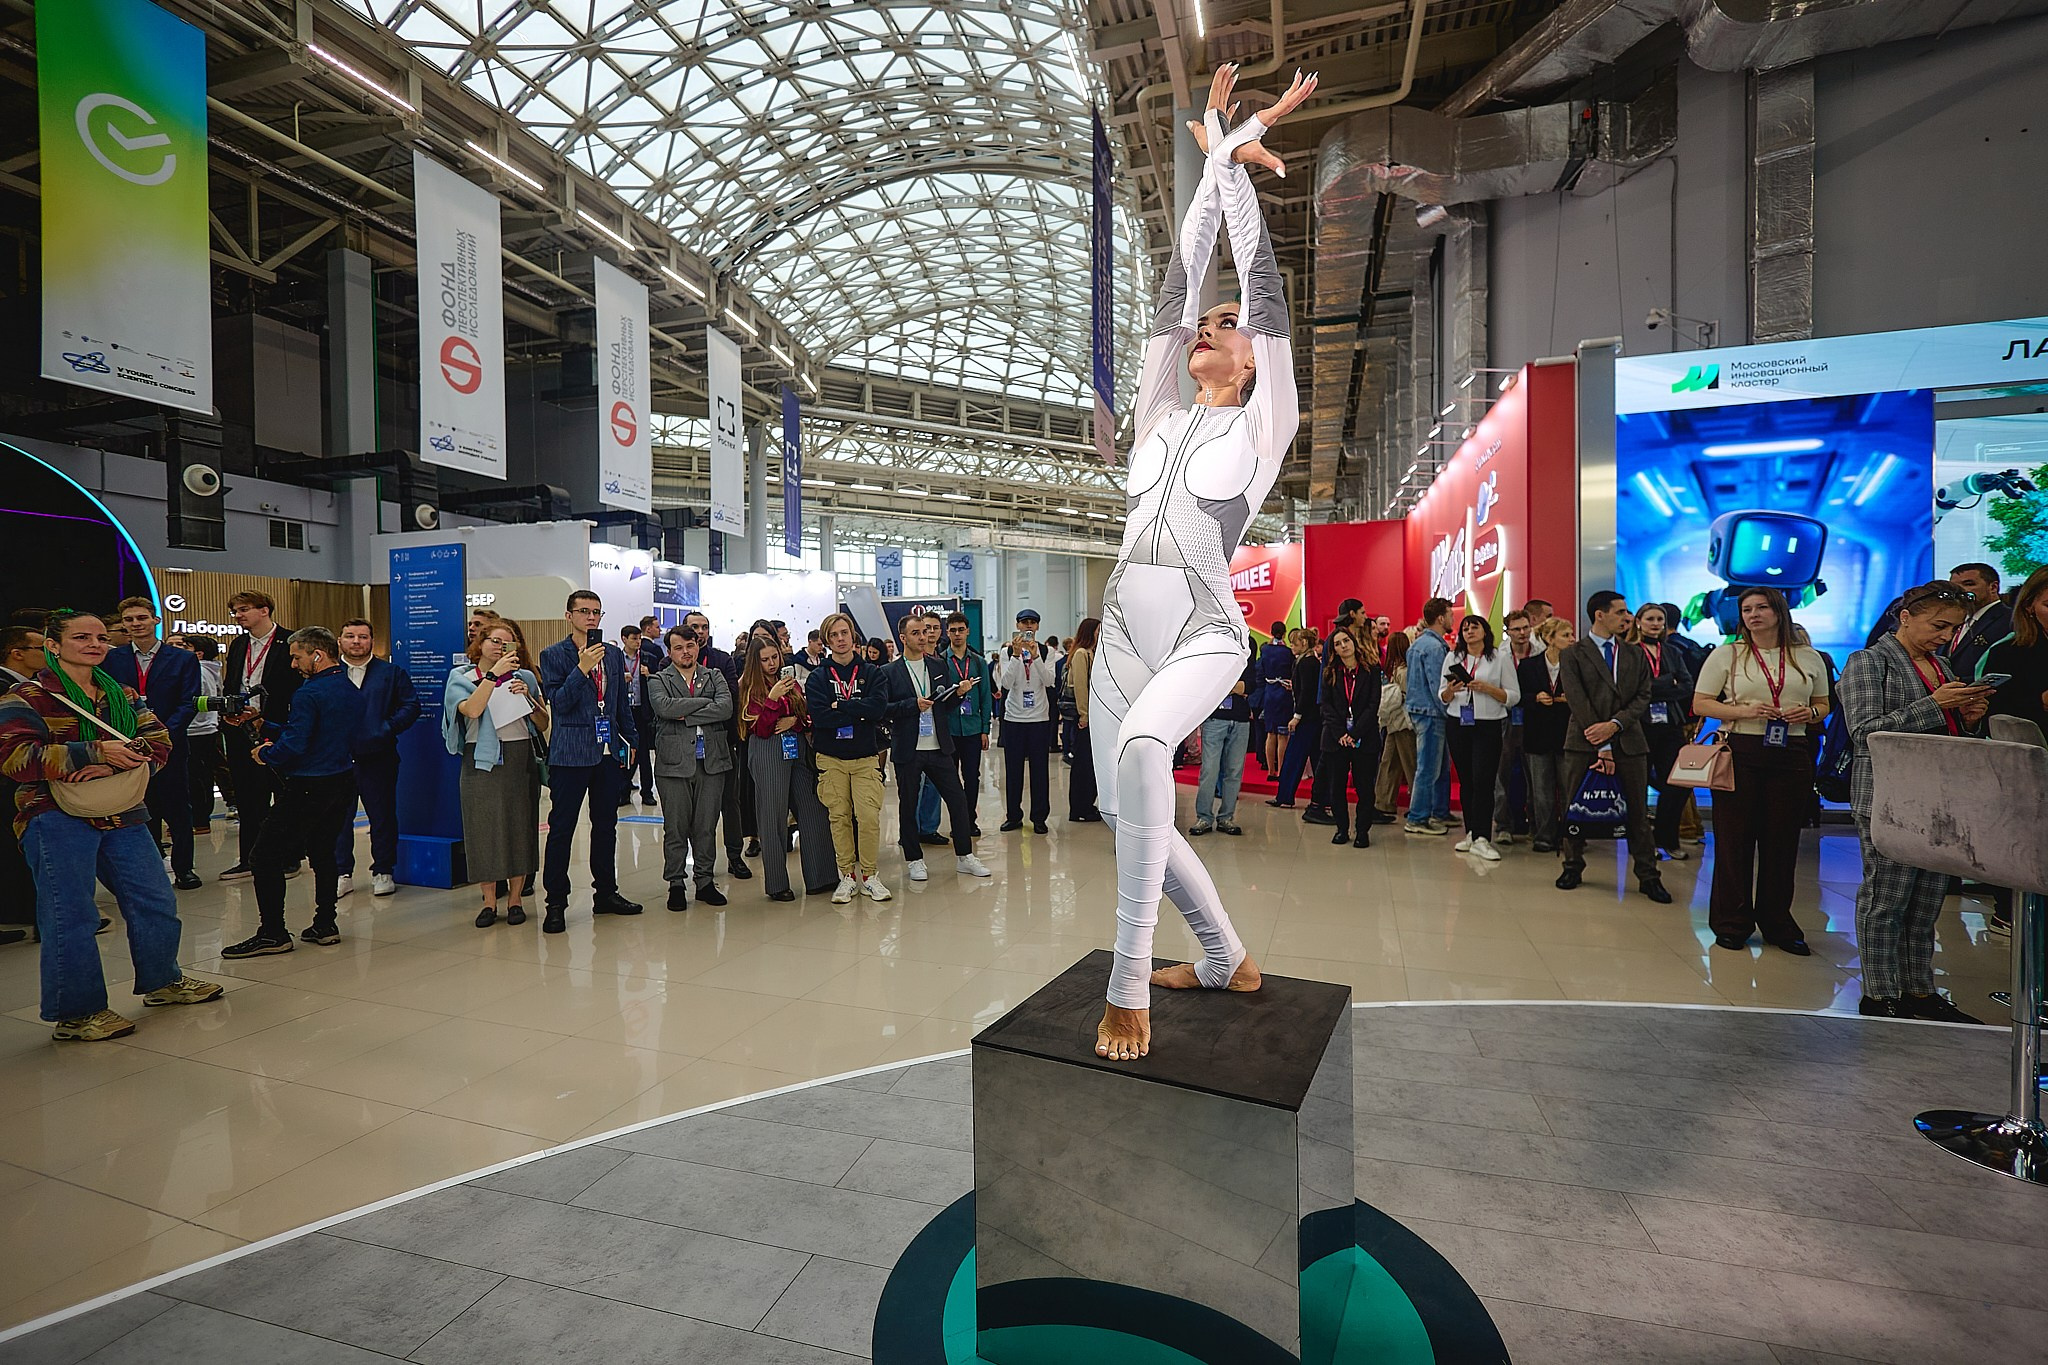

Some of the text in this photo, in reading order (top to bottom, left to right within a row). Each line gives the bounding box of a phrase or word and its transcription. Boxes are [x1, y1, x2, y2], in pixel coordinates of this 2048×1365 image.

[456, 228, 467, 334] ПЕРСПЕКТИВНЫХ
[466, 233, 478, 338] ИССЛЕДОВАНИЙ
[441, 262, 456, 328] ФОНД
[620, 315, 628, 399] ПЕРСПЕКТИВНЫХ
[627, 317, 635, 401] ИССЛЕДОВАНИЙ
[1731, 355, 1807, 370] Московский
[124, 368, 154, 380] YOUNG
[611, 343, 621, 395] ФОНД
[1731, 362, 1829, 379] инновационный
[117, 372, 196, 395] SCIENTISTS CONGRESS
[1731, 377, 1780, 388] кластер
[718, 434, 735, 449] Ростех
[466, 593, 495, 606] СБЕР
[172, 620, 249, 637] Лаборат
